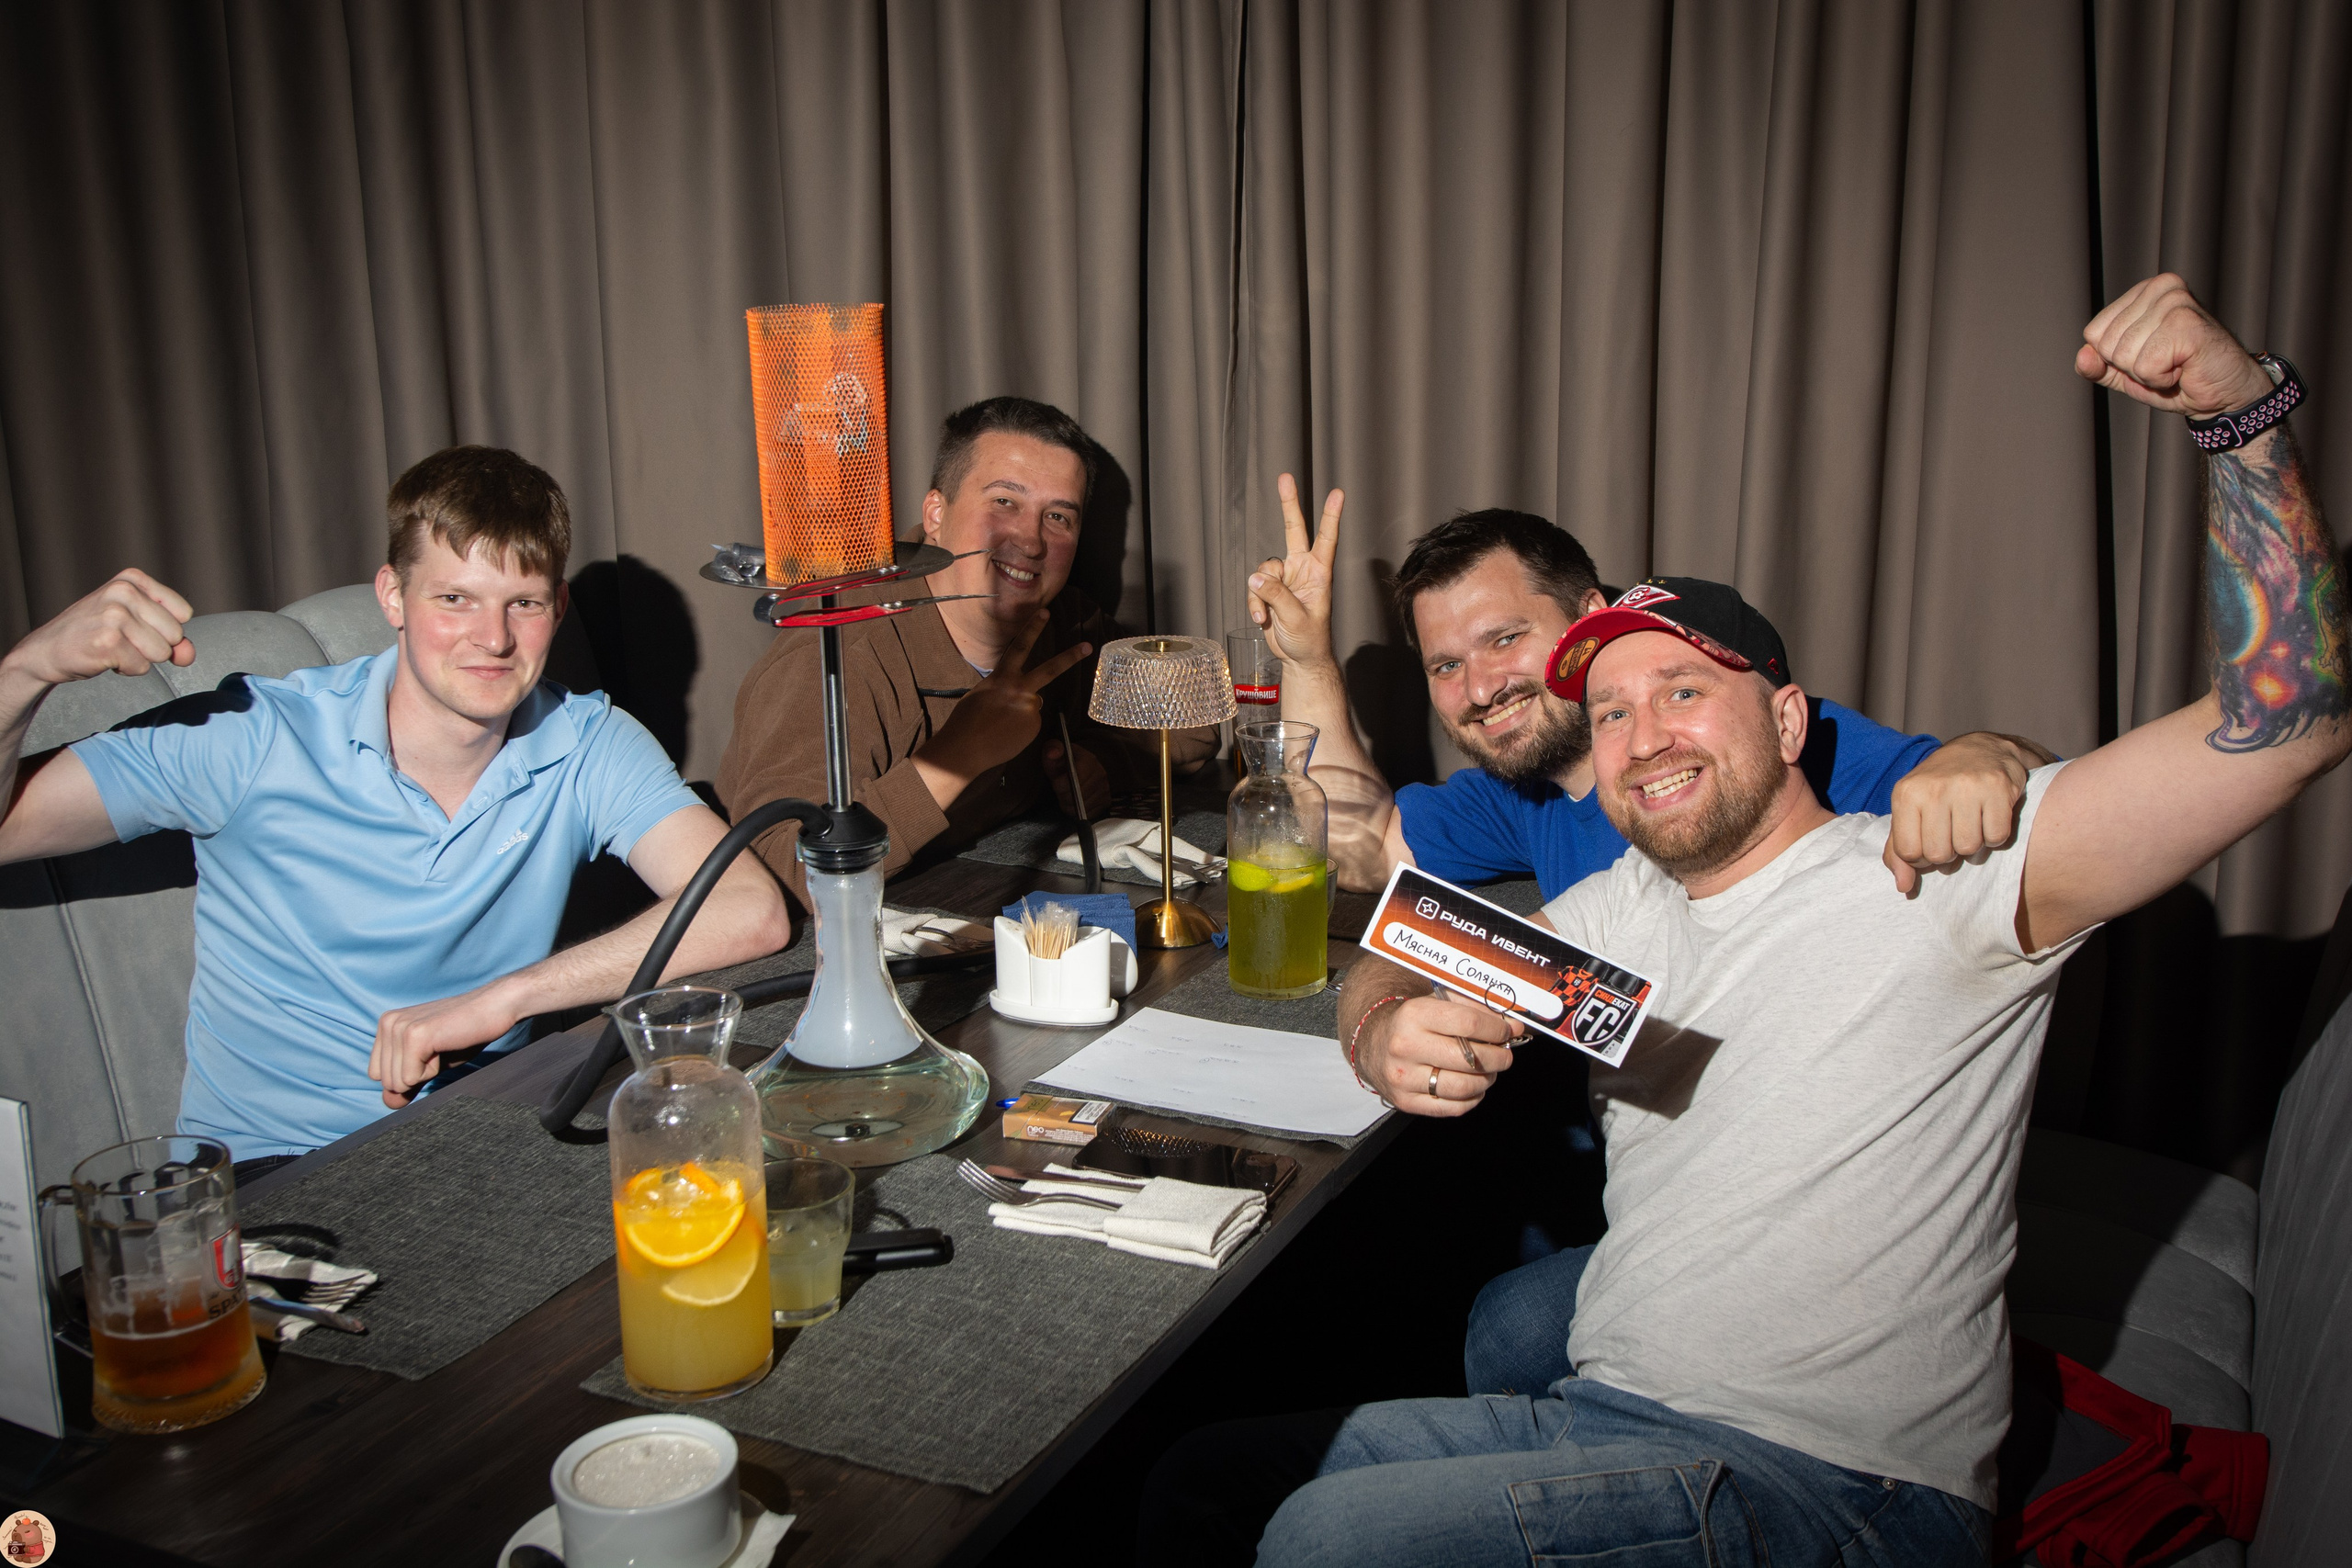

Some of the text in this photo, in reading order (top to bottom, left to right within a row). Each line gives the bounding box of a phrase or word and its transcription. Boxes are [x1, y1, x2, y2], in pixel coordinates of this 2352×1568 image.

[1439, 909, 1551, 967] РУДА ИВЕНТ
[1594, 989, 1631, 1010] СИНДЕКАТ
[1576, 998, 1621, 1042] FC
[1027, 1125, 1045, 1134] neo
